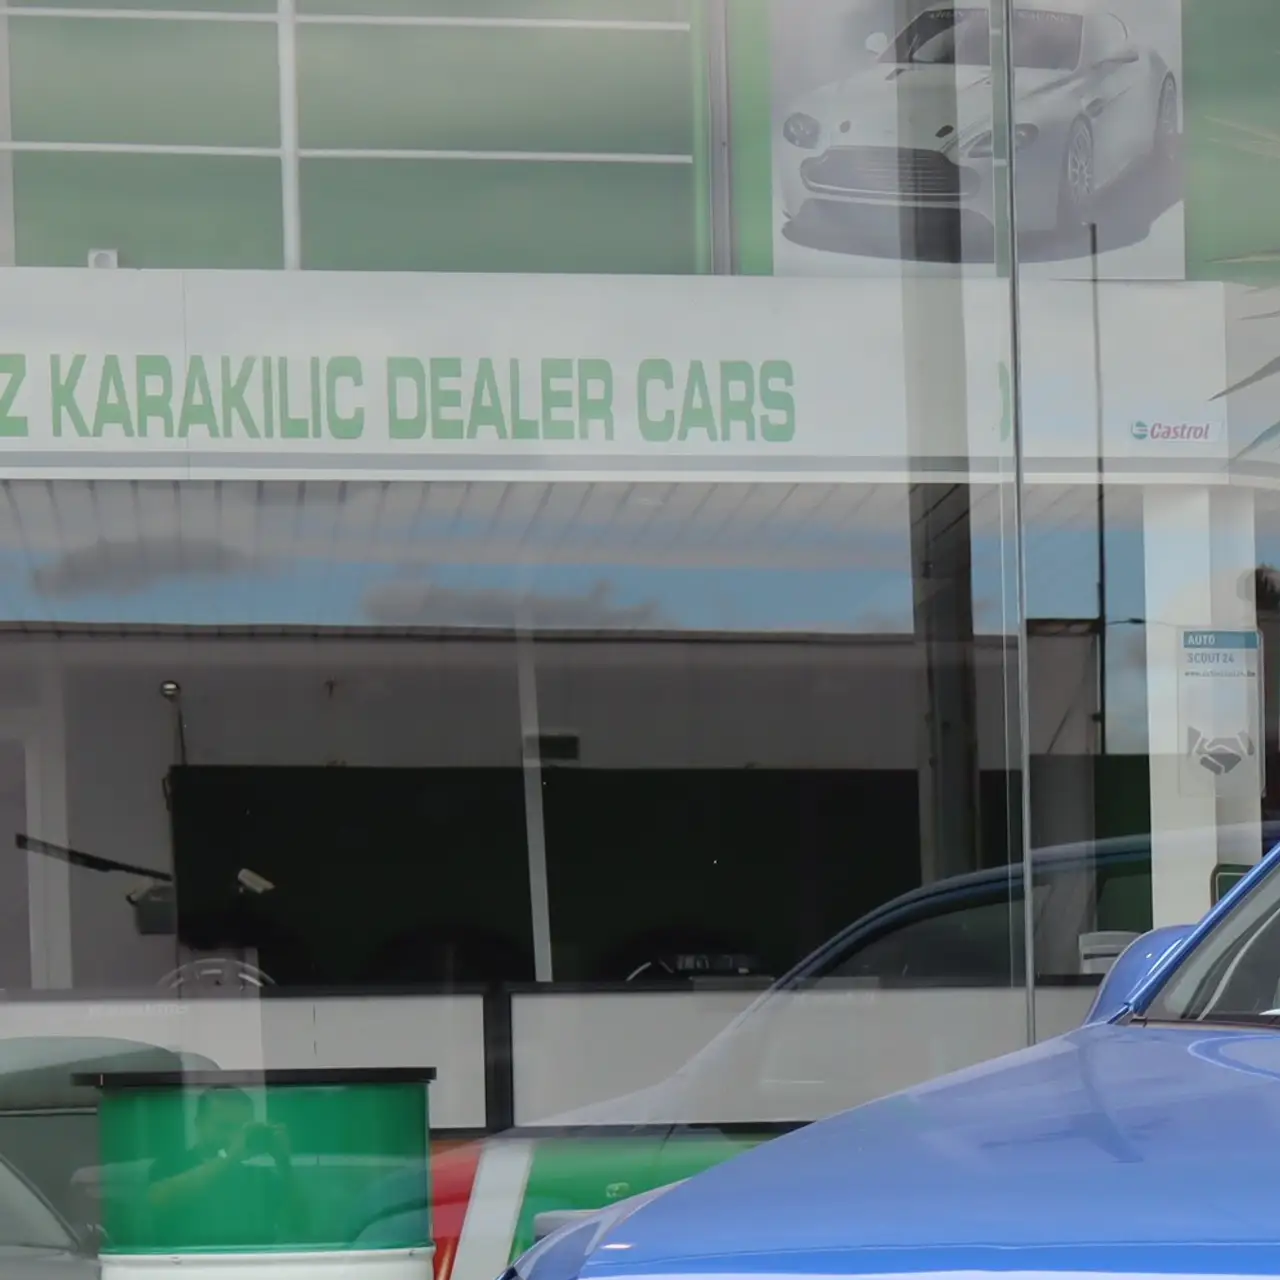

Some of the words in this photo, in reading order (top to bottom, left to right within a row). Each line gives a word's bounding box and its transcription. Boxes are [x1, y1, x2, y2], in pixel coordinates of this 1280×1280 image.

[0, 353, 29, 437] Z
[50, 354, 365, 440] KARAKILIC
[386, 356, 615, 441] DEALER
[637, 358, 796, 443] CARS
[1150, 422, 1210, 441] Castrol
[1188, 634, 1216, 646] AUTO
